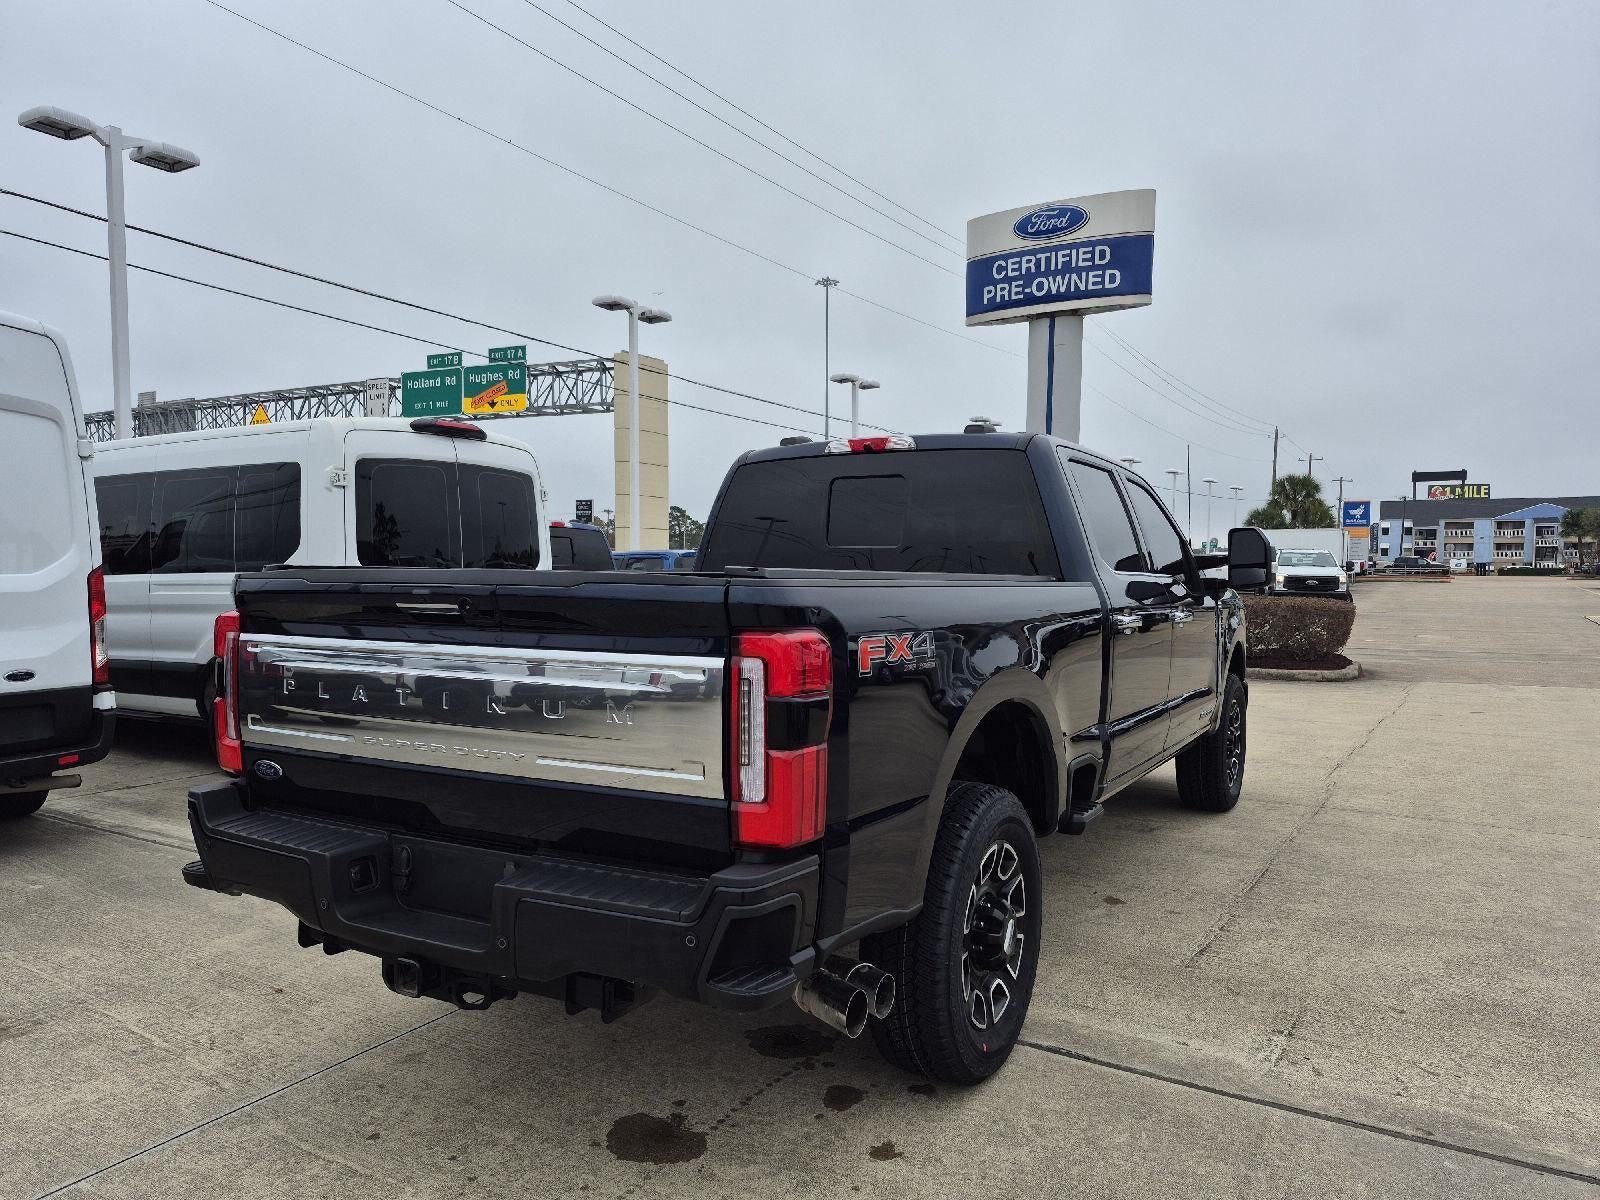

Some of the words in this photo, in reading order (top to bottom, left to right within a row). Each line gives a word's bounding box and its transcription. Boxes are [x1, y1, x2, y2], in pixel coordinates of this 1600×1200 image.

[1027, 209, 1071, 233] Ford
[992, 245, 1112, 280] CERTIFIED
[983, 269, 1122, 305] PRE-OWNED
[491, 350, 504, 359] EXIT
[407, 377, 441, 390] Holland
[445, 375, 456, 386] Rd
[469, 372, 504, 384] Hughes
[508, 369, 520, 380] Rd
[369, 392, 385, 401] LIMIT
[500, 398, 519, 407] ONLY
[429, 400, 433, 410] 1
[1455, 485, 1489, 499] MILE
[858, 630, 936, 677] FX4
[283, 677, 634, 726] PLATINUM
[363, 736, 448, 754] SUPER
[453, 745, 526, 762] DUTY
